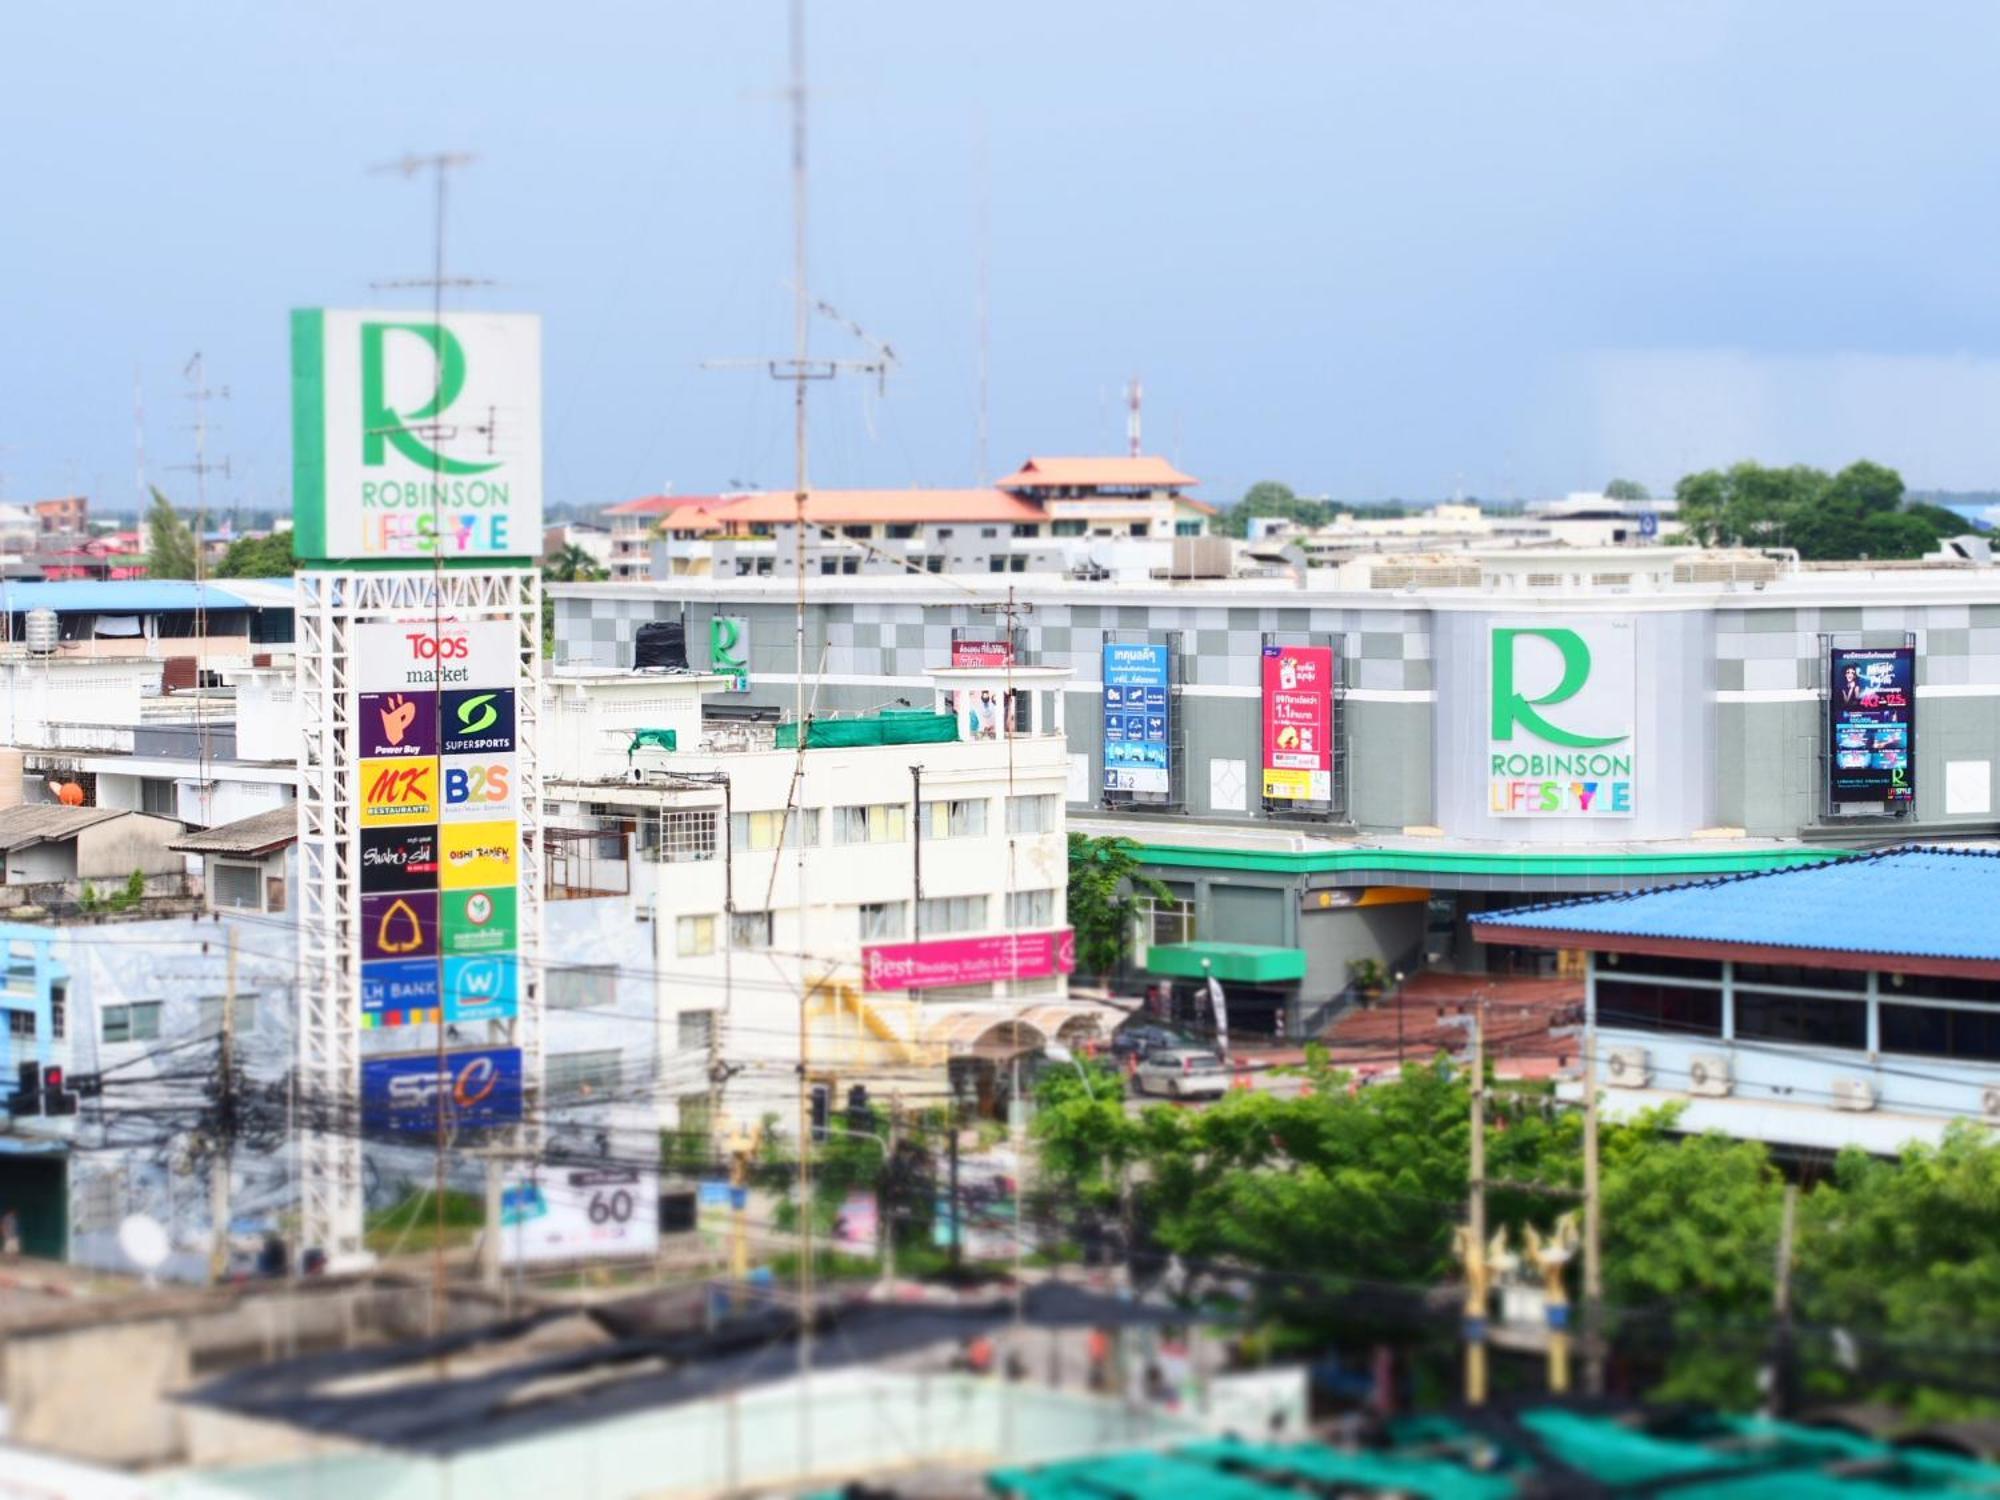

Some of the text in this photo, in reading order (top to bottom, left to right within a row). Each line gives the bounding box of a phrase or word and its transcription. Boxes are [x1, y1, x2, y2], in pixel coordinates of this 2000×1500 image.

[361, 322, 505, 475] R
[362, 481, 509, 508] ROBINSON
[406, 632, 469, 668] Tops
[711, 620, 747, 667] R
[406, 666, 469, 683] market
[1492, 628, 1630, 748] R
[375, 744, 421, 755] Power Buy
[445, 738, 510, 750] SUPERSPORTS
[1492, 754, 1631, 776] ROBINSON
[368, 767, 430, 803] MK
[445, 764, 509, 804] B2S
[1492, 781, 1631, 812] LIFESTYLE
[450, 847, 509, 860] OISHI RAMEN
[870, 950, 915, 978] Best
[364, 981, 437, 999] LH BANK
[588, 1189, 633, 1225] 60
